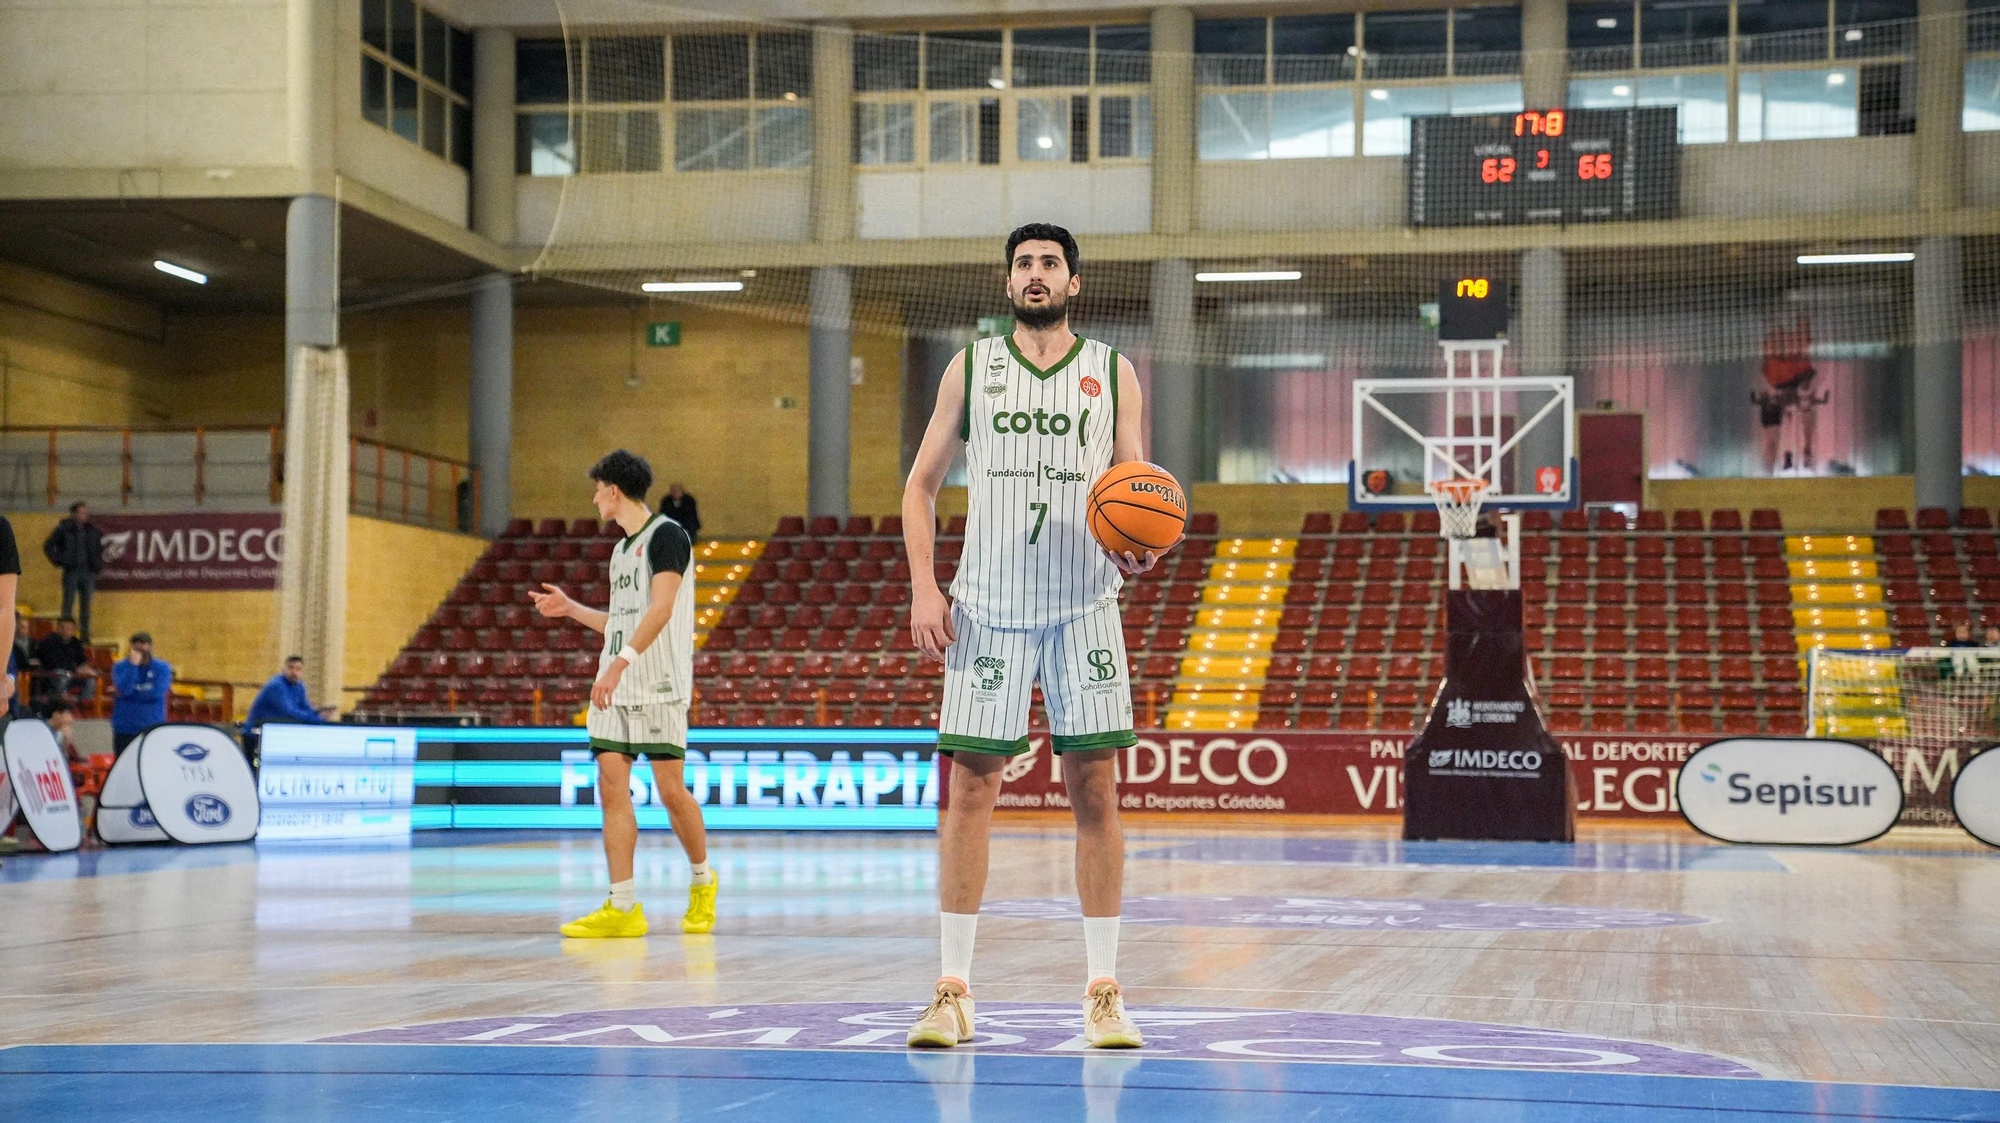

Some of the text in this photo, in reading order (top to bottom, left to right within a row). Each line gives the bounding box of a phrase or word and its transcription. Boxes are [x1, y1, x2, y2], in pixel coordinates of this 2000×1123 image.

[1482, 157, 1516, 183] 62
[1578, 153, 1612, 180] 66
[992, 408, 1071, 436] coto
[987, 468, 1035, 478] Fundación
[1130, 482, 1185, 512] Wilson
[1029, 502, 1048, 545] 7
[609, 630, 622, 656] 10
[1080, 681, 1122, 692] SohoBoutique
[1050, 738, 1289, 787] IDECO
[1454, 748, 1543, 771] IMDECO
[180, 765, 214, 783] TYSA
[1121, 793, 1143, 809] de
[1145, 793, 1217, 812] Deportes
[1218, 793, 1286, 810] Córdoba
[1727, 772, 1877, 815] Sepisur
[193, 797, 224, 824] Ford
